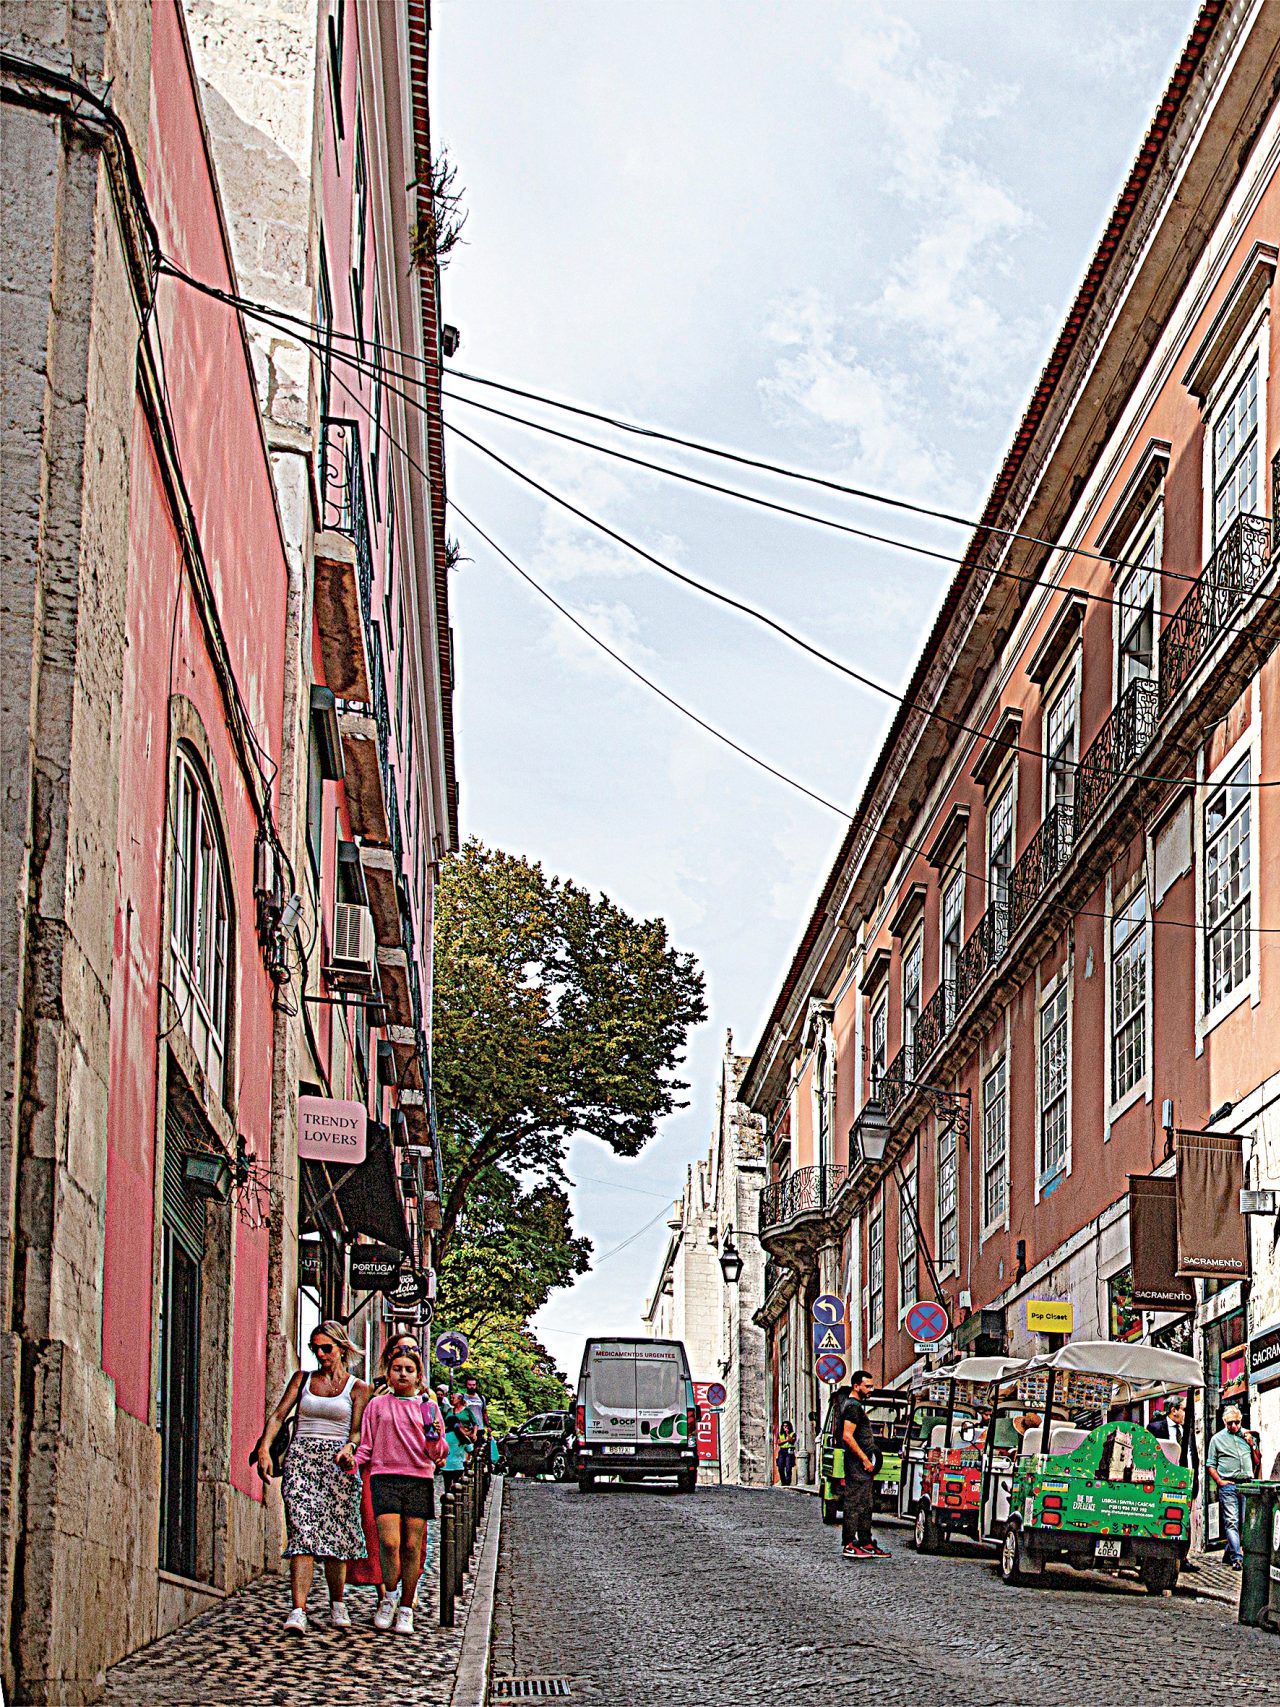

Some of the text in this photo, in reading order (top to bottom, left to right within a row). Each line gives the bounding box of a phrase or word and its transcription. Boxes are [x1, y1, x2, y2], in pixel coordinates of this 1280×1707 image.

[304, 1113, 358, 1129] TRENDY
[305, 1131, 357, 1146] LOVERS
[1183, 1256, 1243, 1268] SACRAMENTO
[1134, 1290, 1192, 1301] SACRAMENTO
[1031, 1312, 1068, 1321] Pop Closet
[1102, 1541, 1115, 1549] AX
